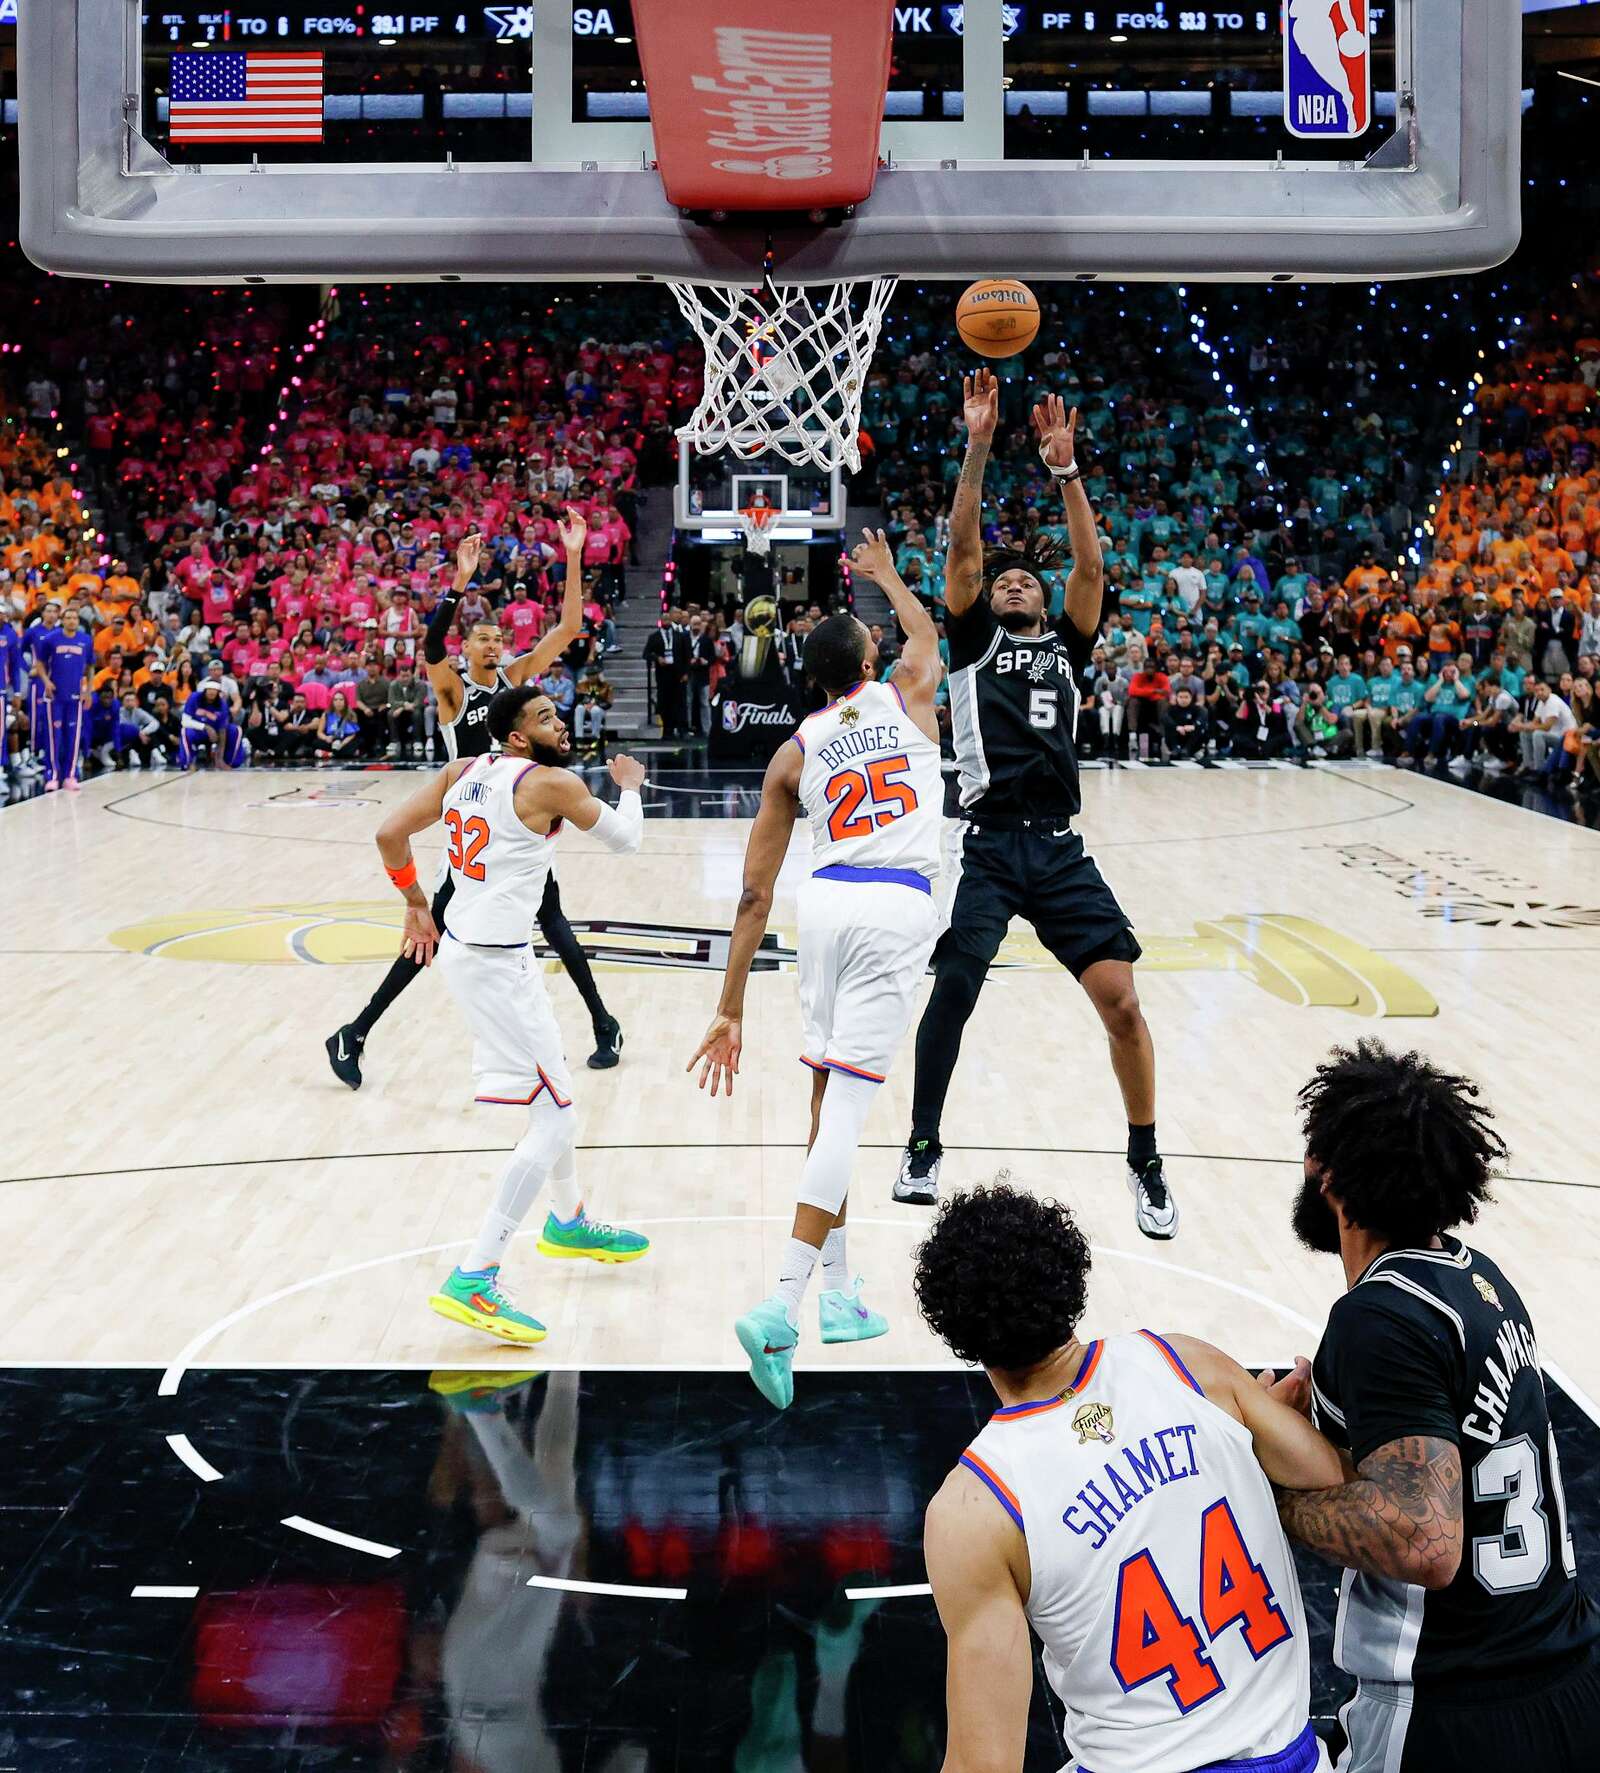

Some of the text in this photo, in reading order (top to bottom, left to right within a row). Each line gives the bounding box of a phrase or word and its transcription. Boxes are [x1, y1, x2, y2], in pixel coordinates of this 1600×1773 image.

[162, 15, 186, 24] STL
[198, 15, 223, 24] BLK
[207, 25, 215, 40] 2
[237, 18, 267, 34] TO
[304, 17, 356, 34] FG%
[411, 17, 439, 33] PF
[456, 15, 466, 33] 4
[574, 8, 614, 35] SA
[894, 8, 932, 32] YK
[1043, 13, 1071, 29] PF
[1116, 12, 1169, 29] FG%
[1213, 13, 1243, 29] TO
[1298, 95, 1338, 124] NBA
[972, 289, 1028, 305] Wilson
[730, 703, 796, 733] Finals
[1029, 688, 1058, 729] 5
[818, 726, 899, 771] BRIDGES
[824, 754, 919, 842] 25
[444, 808, 490, 881] 32
[1074, 1404, 1111, 1437] Finals
[1062, 1424, 1200, 1550] SHAMET
[1110, 1496, 1293, 1716] 44
